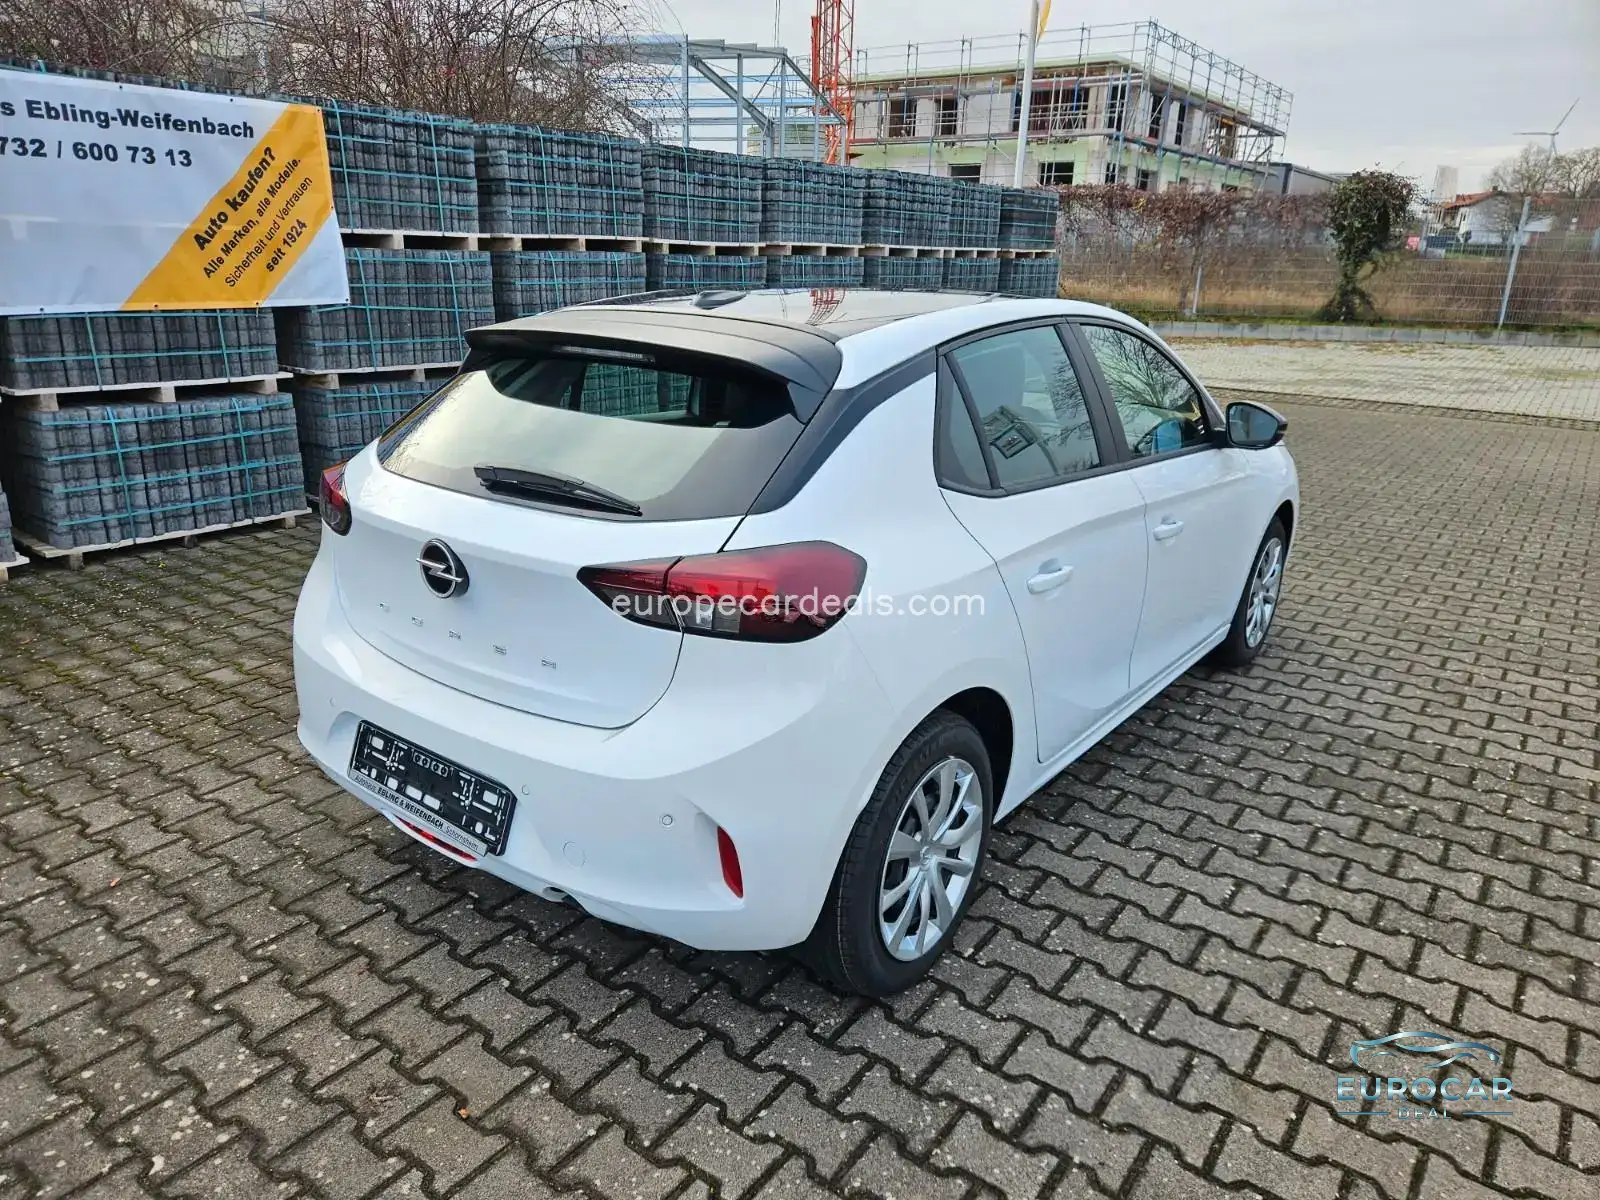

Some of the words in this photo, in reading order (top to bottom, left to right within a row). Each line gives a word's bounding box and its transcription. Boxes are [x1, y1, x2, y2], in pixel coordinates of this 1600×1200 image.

[25, 99, 254, 138] Ebling-Weifenbach
[72, 141, 118, 162] 600
[126, 145, 156, 166] 73
[165, 149, 193, 168] 13
[193, 211, 228, 251] Auto
[225, 147, 276, 212] kaufen?
[203, 256, 225, 279] Alle
[220, 218, 259, 257] Marken,
[256, 197, 271, 217] alle
[267, 159, 301, 198] Modelle.
[225, 239, 267, 287] Sicherheit
[265, 220, 281, 241] und
[276, 177, 313, 221] Vertrauen
[266, 247, 286, 272] seit
[282, 219, 308, 248] 1924
[378, 786, 399, 804] EBLING
[404, 801, 444, 829] WEIFENBACH
